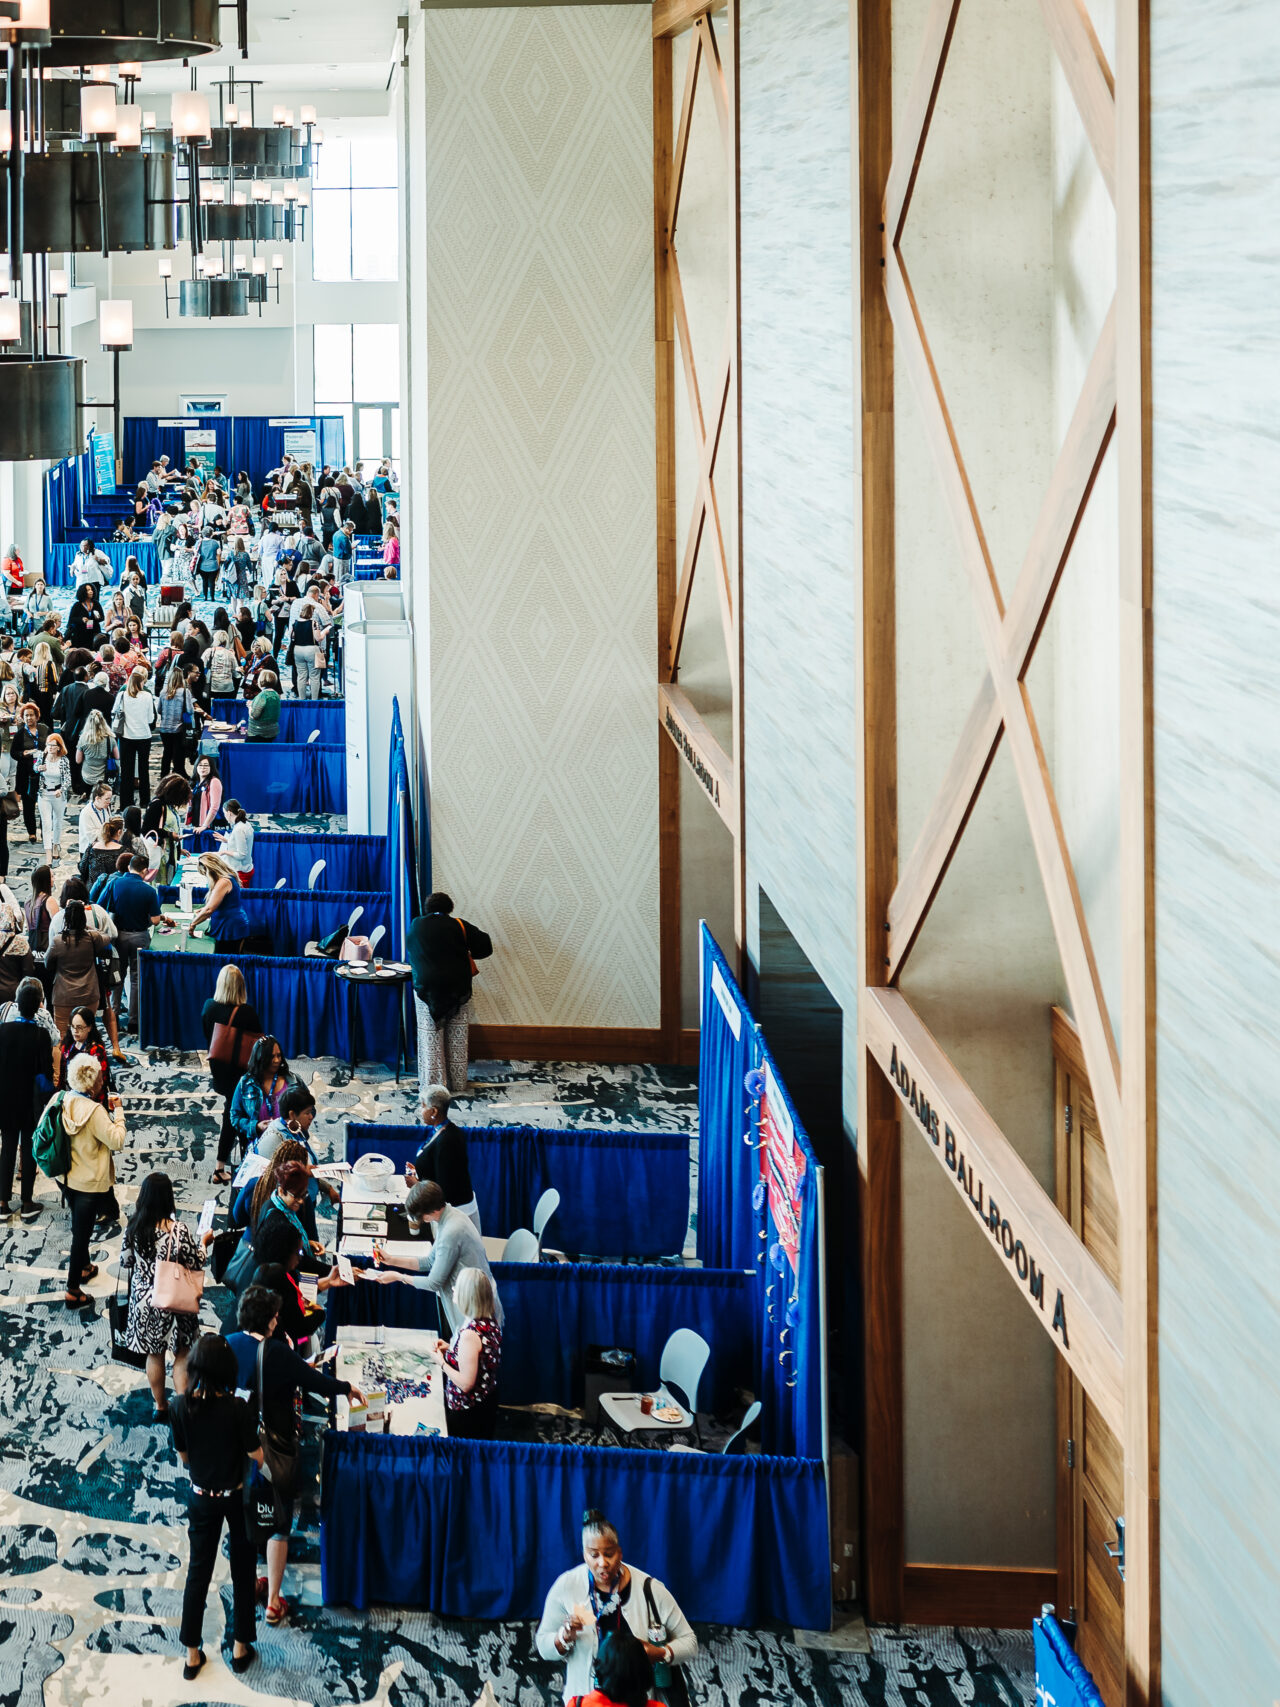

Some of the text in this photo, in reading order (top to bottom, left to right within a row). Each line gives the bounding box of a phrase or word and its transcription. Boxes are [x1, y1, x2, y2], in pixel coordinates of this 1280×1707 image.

[889, 1043, 1070, 1350] ADAMS BALLROOM A
